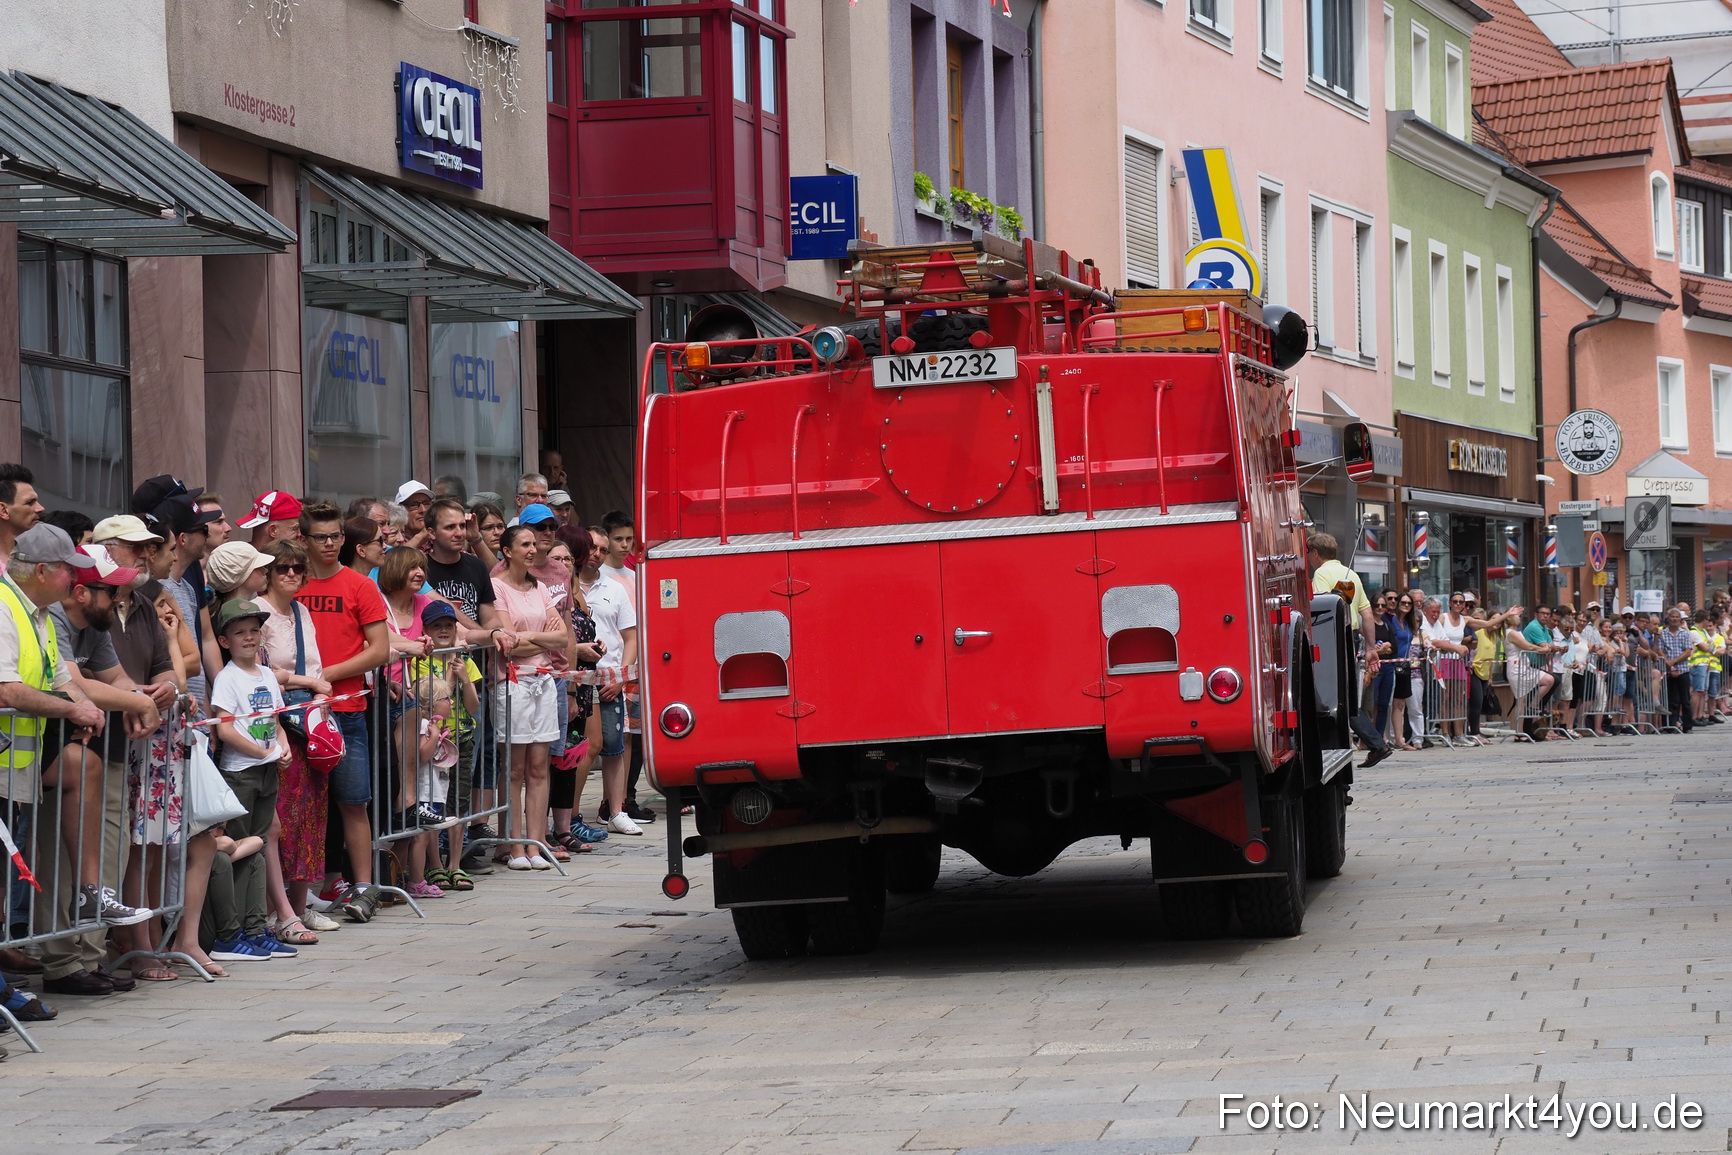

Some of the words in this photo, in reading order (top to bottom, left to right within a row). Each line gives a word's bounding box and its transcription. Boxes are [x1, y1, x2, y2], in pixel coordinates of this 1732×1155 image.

[224, 82, 288, 123] Klostergasse
[289, 104, 296, 127] 2
[413, 77, 481, 151] CECIL
[805, 227, 820, 235] 1989
[330, 330, 387, 386] CECIL
[453, 353, 501, 403] CECIL
[1583, 413, 1616, 435] FRISEURE
[1643, 478, 1694, 496] Creppresso
[1560, 502, 1592, 510] Klostergasse
[1636, 535, 1657, 544] ZONE
